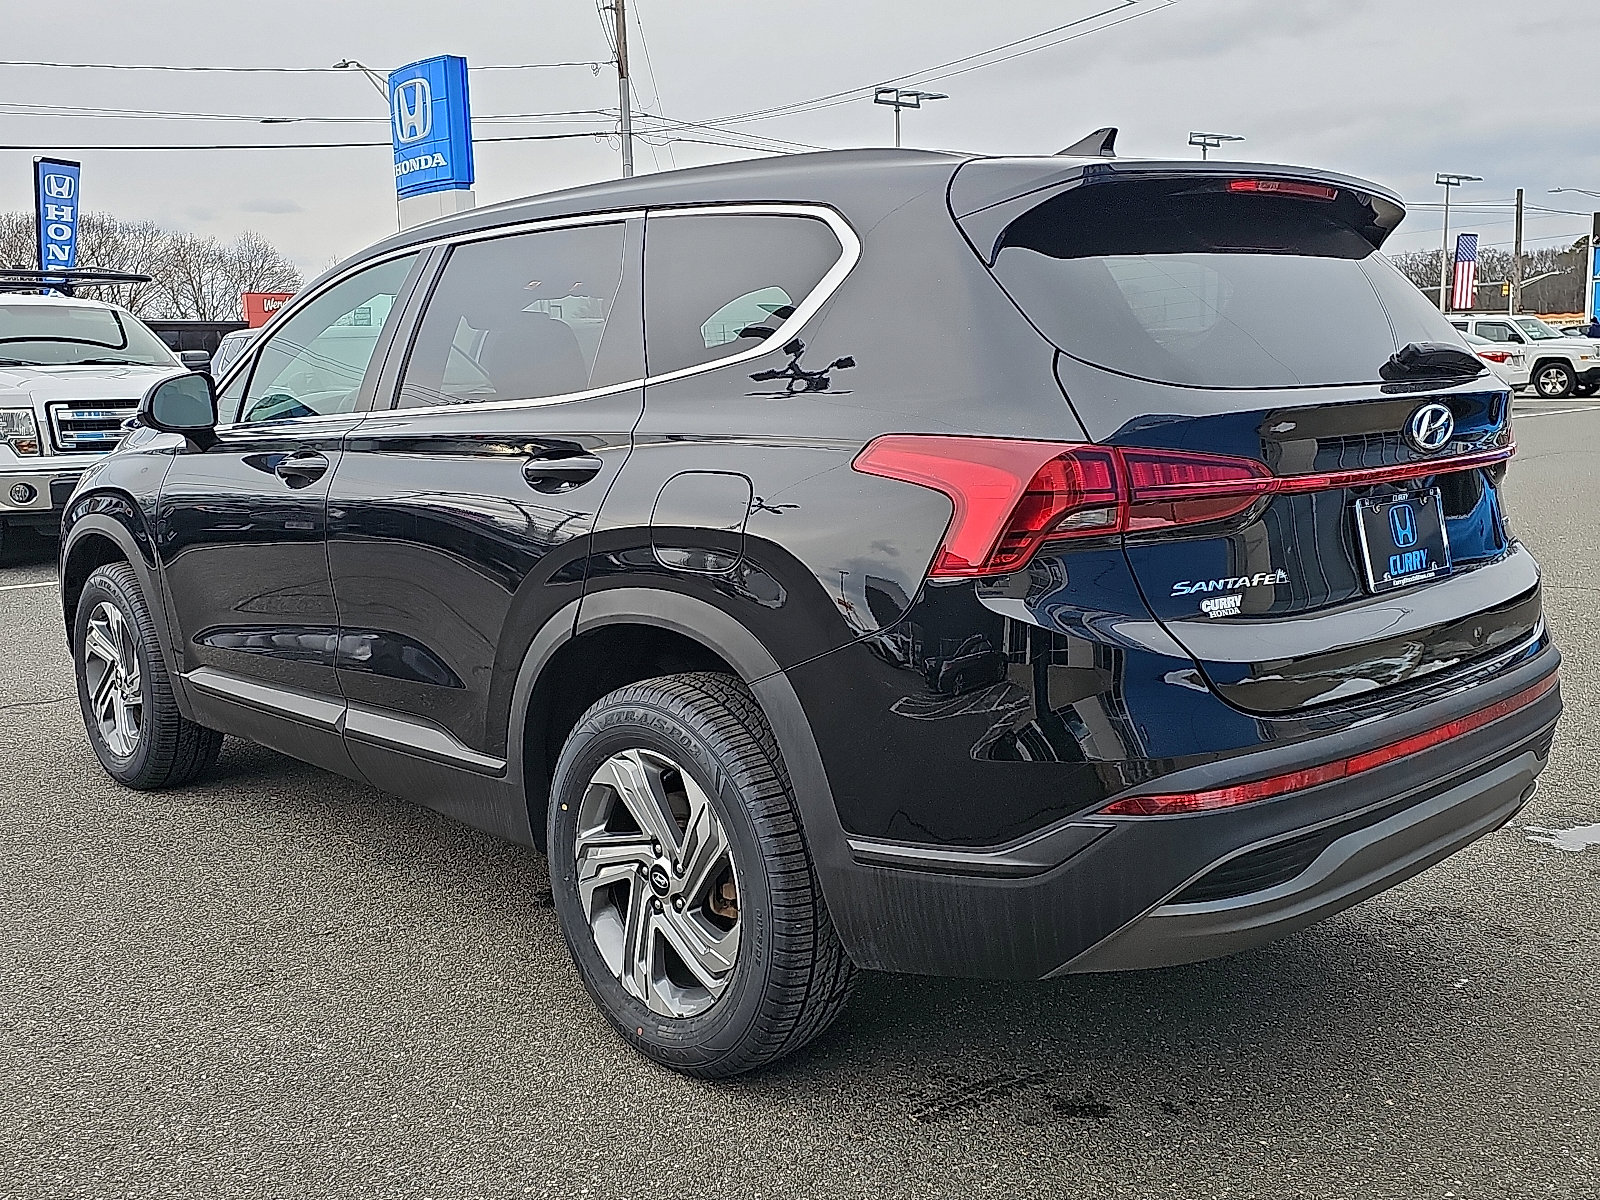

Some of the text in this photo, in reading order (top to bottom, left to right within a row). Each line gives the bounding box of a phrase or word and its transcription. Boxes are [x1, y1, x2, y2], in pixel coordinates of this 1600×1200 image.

[394, 152, 448, 177] HONDA
[1389, 548, 1428, 576] CURRY
[1200, 593, 1243, 613] CURRY
[1208, 607, 1242, 619] HONDA
